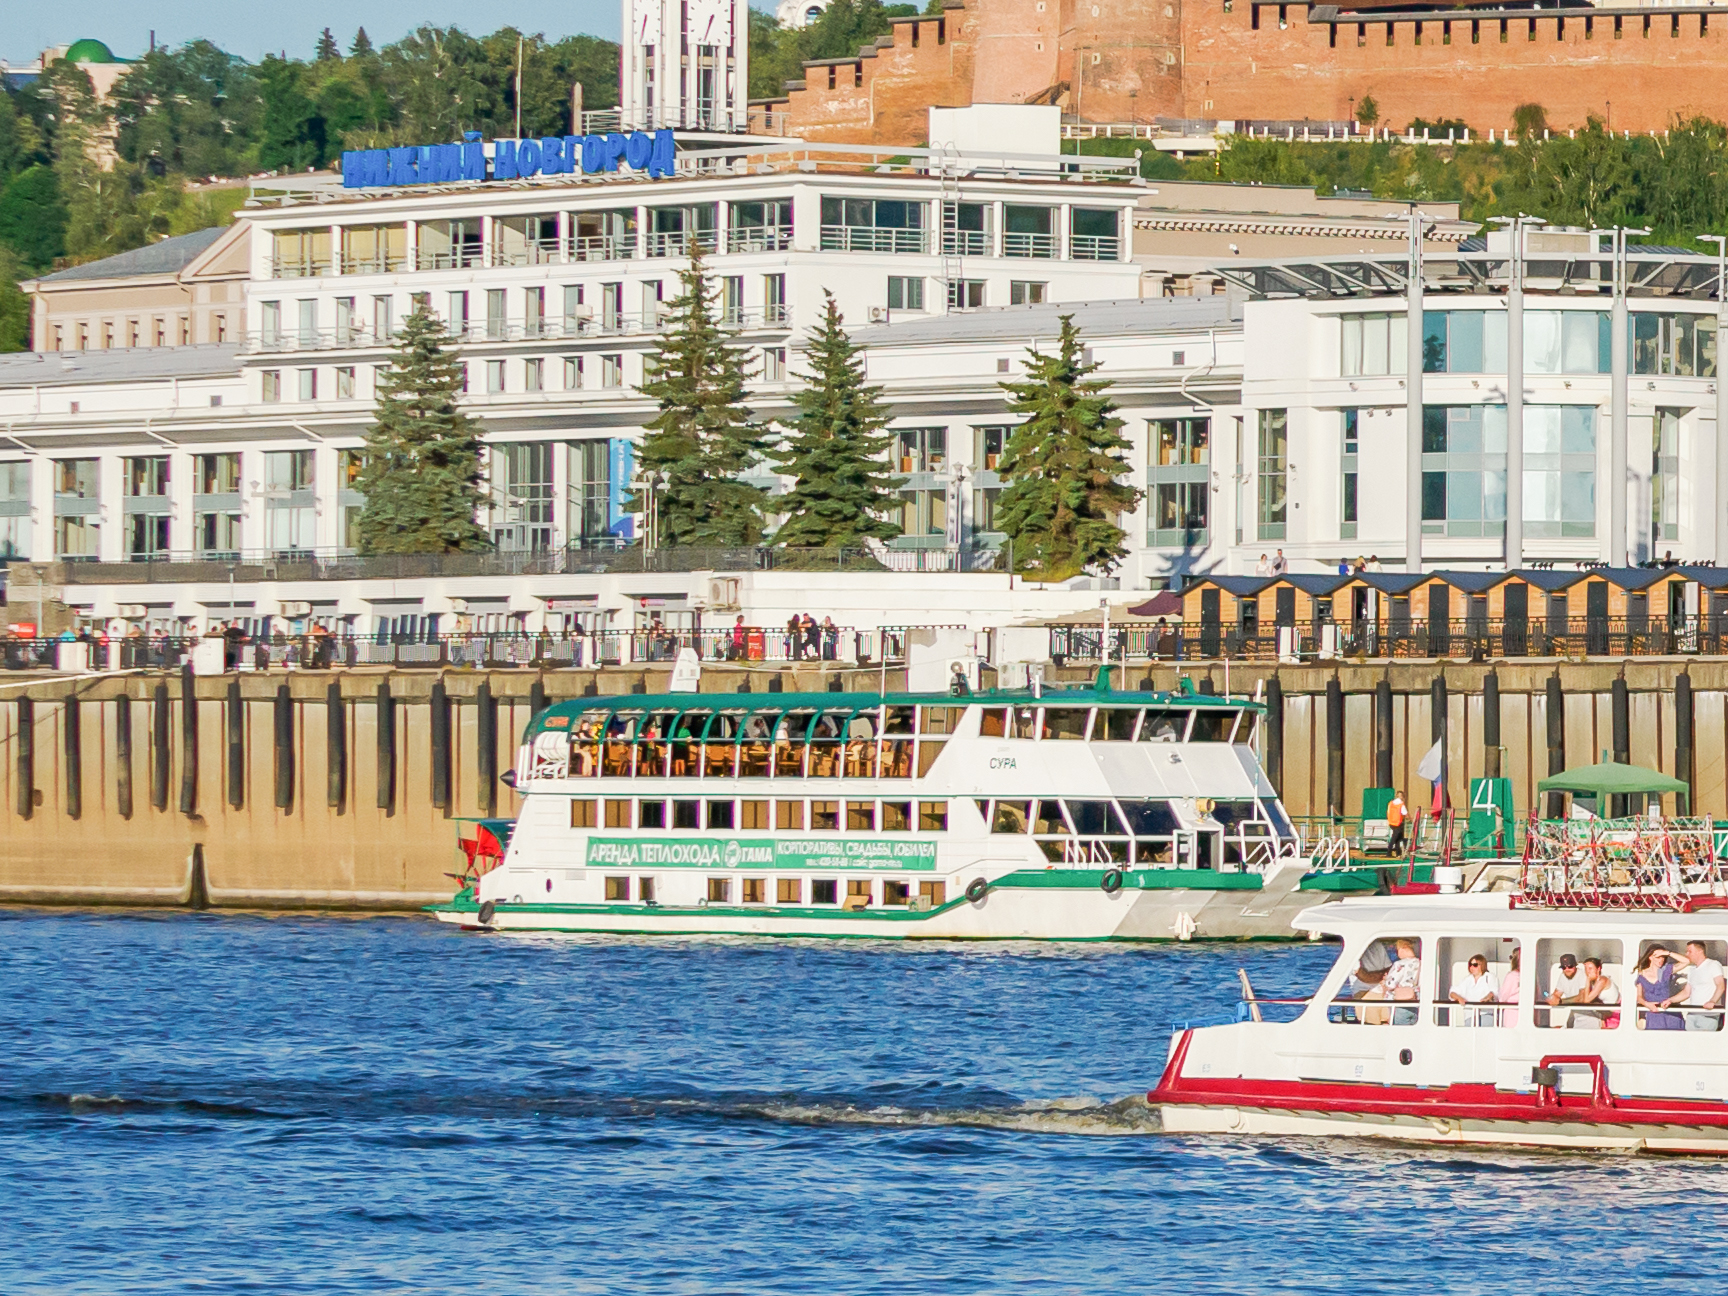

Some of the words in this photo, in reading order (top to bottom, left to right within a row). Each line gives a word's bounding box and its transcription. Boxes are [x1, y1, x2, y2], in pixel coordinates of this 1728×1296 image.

[494, 128, 676, 179] НОВГОРОД
[990, 757, 1017, 769] СУРА
[1472, 779, 1496, 816] 4
[589, 843, 640, 866] АРЕНДА
[641, 843, 721, 866] ТЕПЛОХОДА
